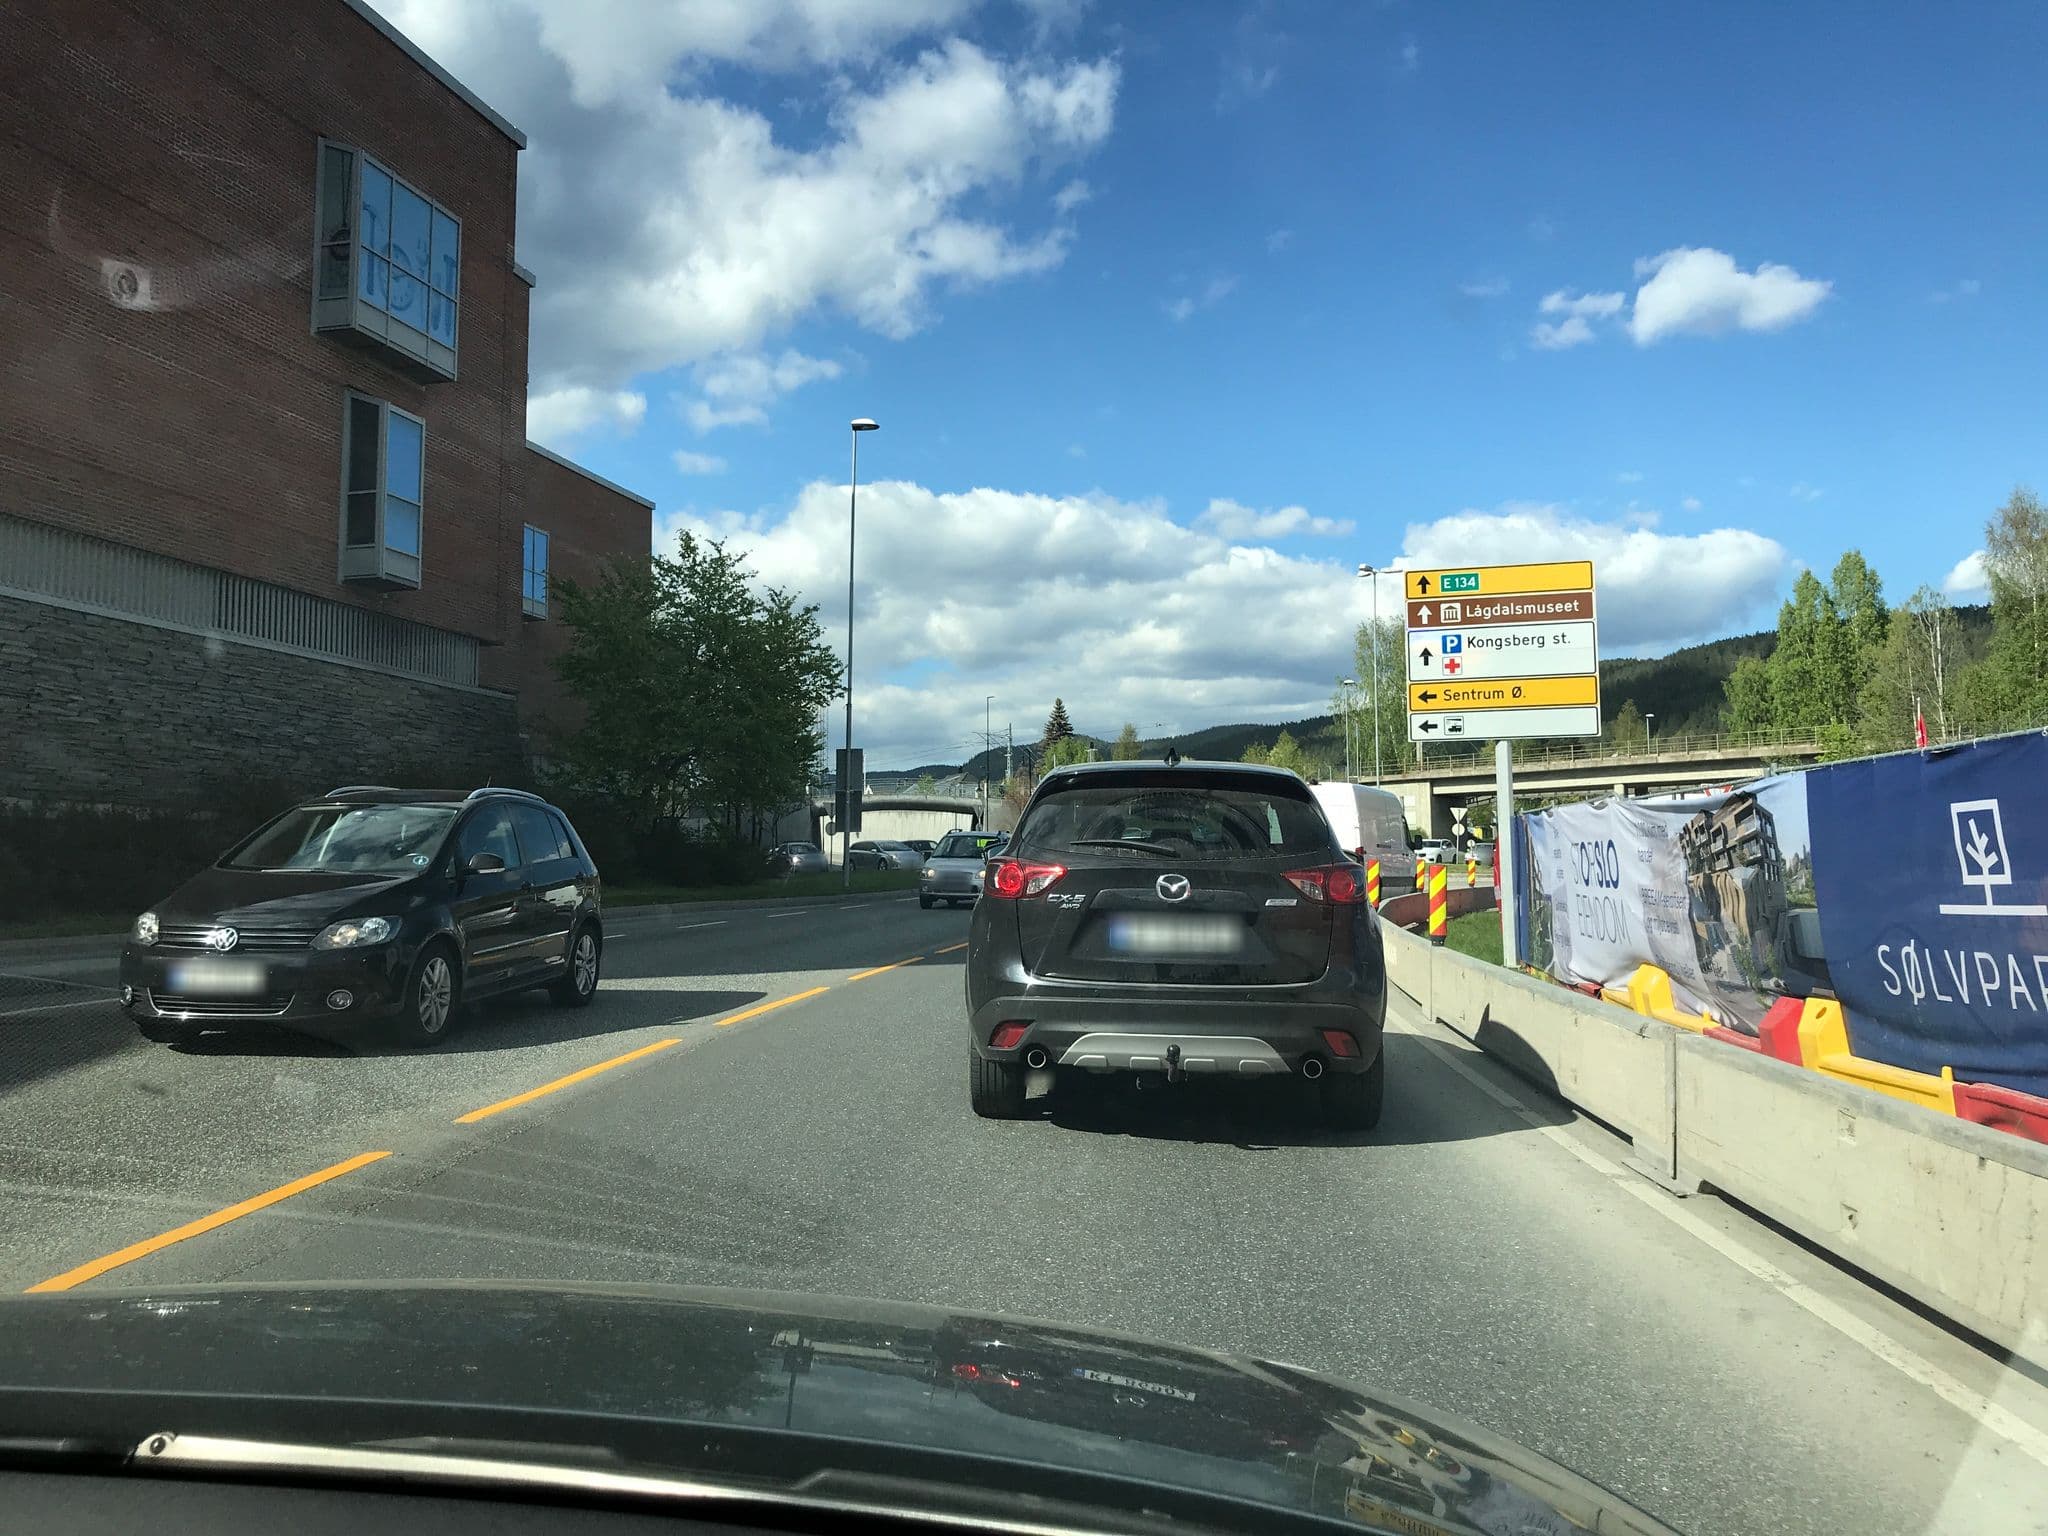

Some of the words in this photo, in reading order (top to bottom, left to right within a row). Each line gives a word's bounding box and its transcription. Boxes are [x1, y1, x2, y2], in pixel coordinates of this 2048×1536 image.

[1443, 578, 1452, 589] E
[1454, 576, 1476, 588] 134
[1465, 599, 1580, 619] Lågdalsmuseet
[1466, 634, 1546, 650] Kongsberg
[1552, 632, 1572, 645] st.
[1443, 688, 1505, 702] Sentrum
[1511, 685, 1527, 699] Ø.
[1046, 893, 1087, 904] CX-5
